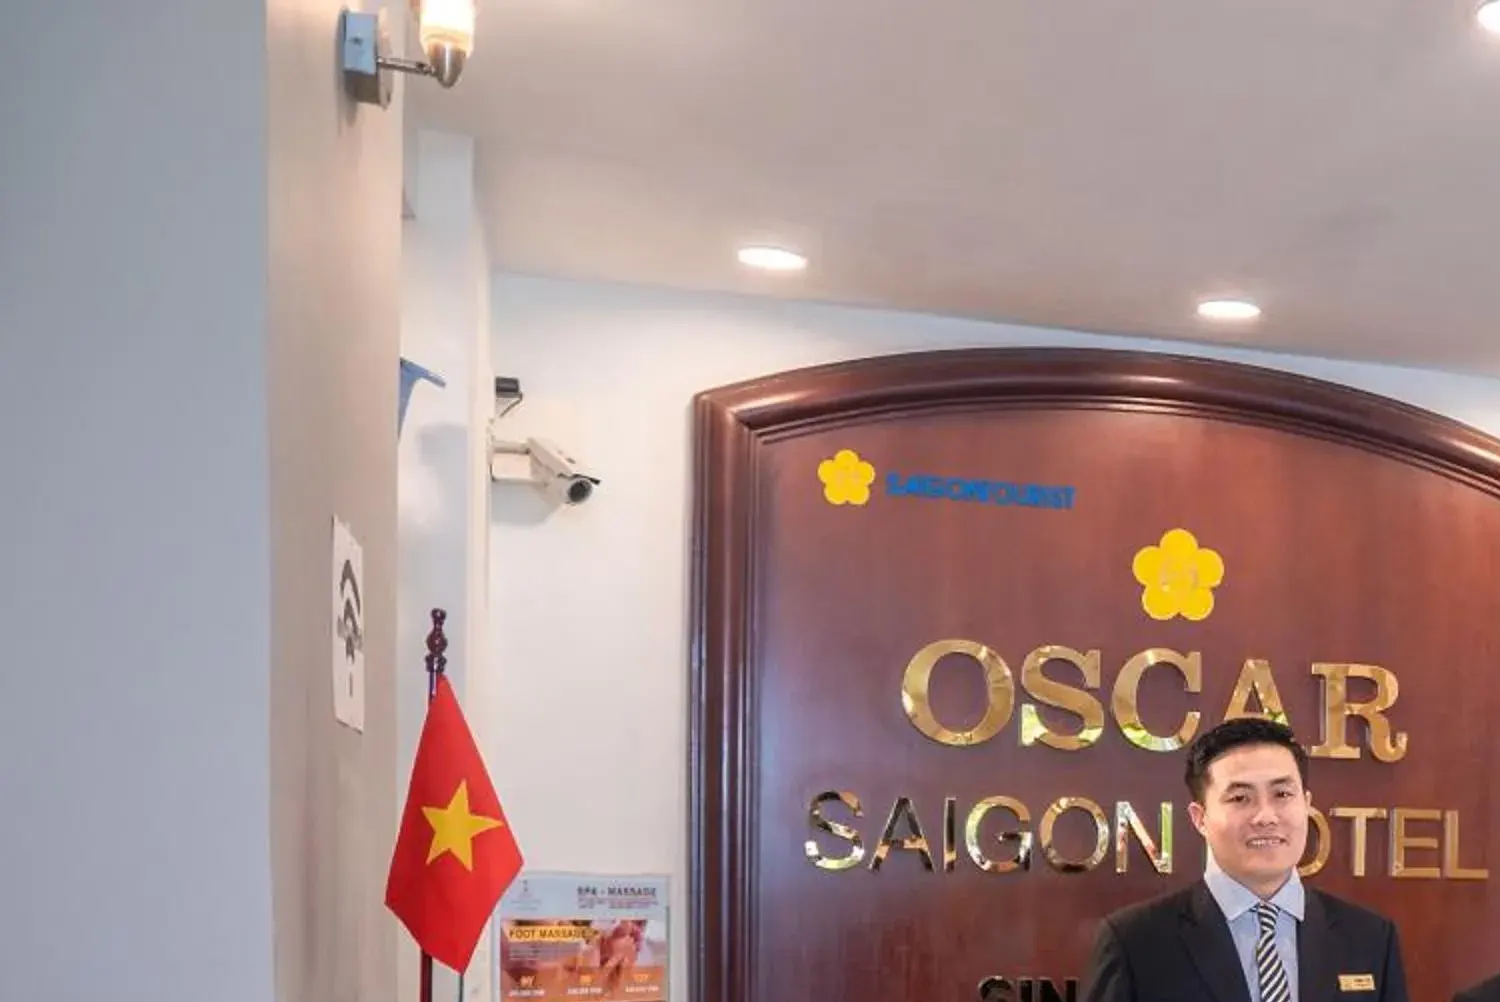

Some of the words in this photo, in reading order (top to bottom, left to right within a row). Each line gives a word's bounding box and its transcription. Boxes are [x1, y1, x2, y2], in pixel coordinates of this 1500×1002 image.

[901, 639, 1408, 764] OSCAR
[803, 790, 1173, 875] SAIGON
[1297, 804, 1489, 880] OTEL
[608, 887, 656, 897] MASSAGE
[539, 928, 587, 939] MASSAGE
